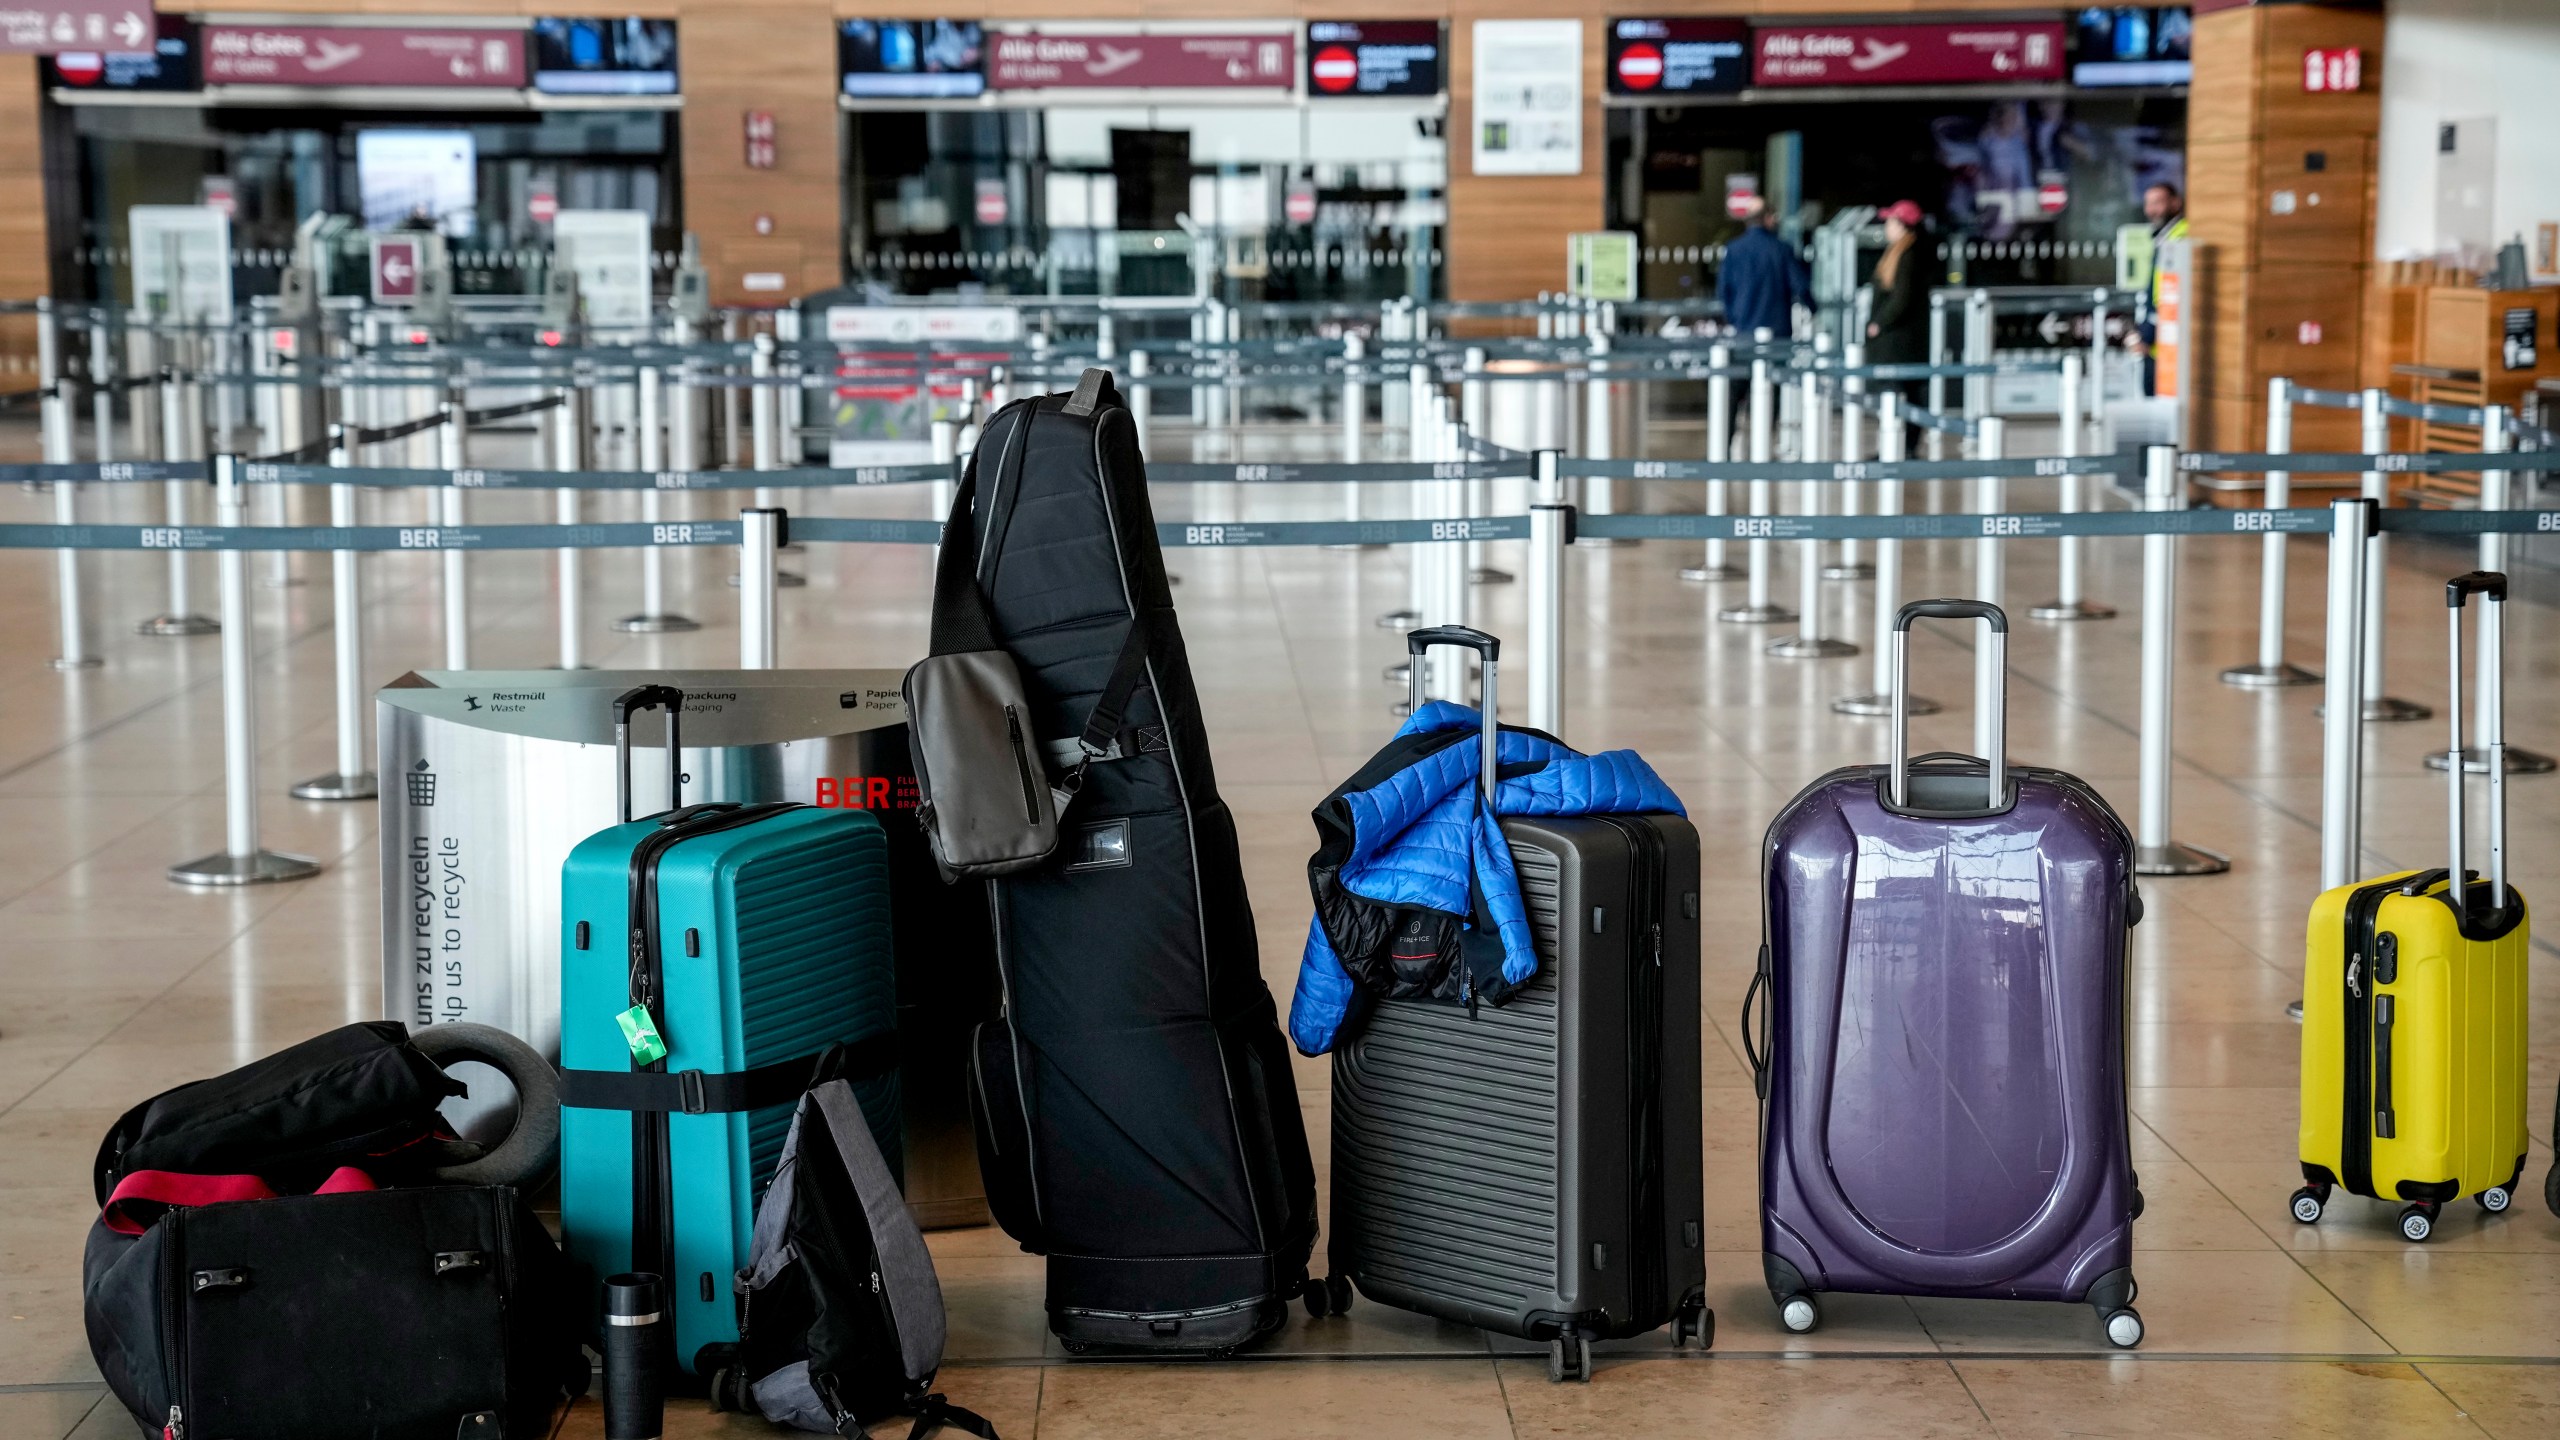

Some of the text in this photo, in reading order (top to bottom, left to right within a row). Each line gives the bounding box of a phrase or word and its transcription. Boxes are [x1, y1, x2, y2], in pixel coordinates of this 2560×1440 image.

[100, 463, 133, 481] BER
[246, 464, 279, 482] BER
[452, 470, 485, 488] BER
[656, 471, 688, 488] BER
[1431, 521, 1470, 540] BER
[1734, 518, 1773, 537] BER
[1982, 516, 2021, 535] BER
[2233, 512, 2273, 531] BER
[2537, 512, 2560, 531] BE
[141, 528, 182, 547] BER
[399, 528, 439, 548] BER
[653, 525, 692, 543] BER
[1186, 526, 1224, 544] BER
[492, 692, 545, 701] Restmüll
[865, 701, 898, 711] Paper
[490, 704, 526, 712] Waste
[897, 777, 919, 785] FLU
[816, 777, 890, 809] BER
[437, 837, 465, 919] recycle
[408, 836, 436, 1026] uns zu recyceln
[441, 929, 461, 952] to
[446, 961, 462, 986] us
